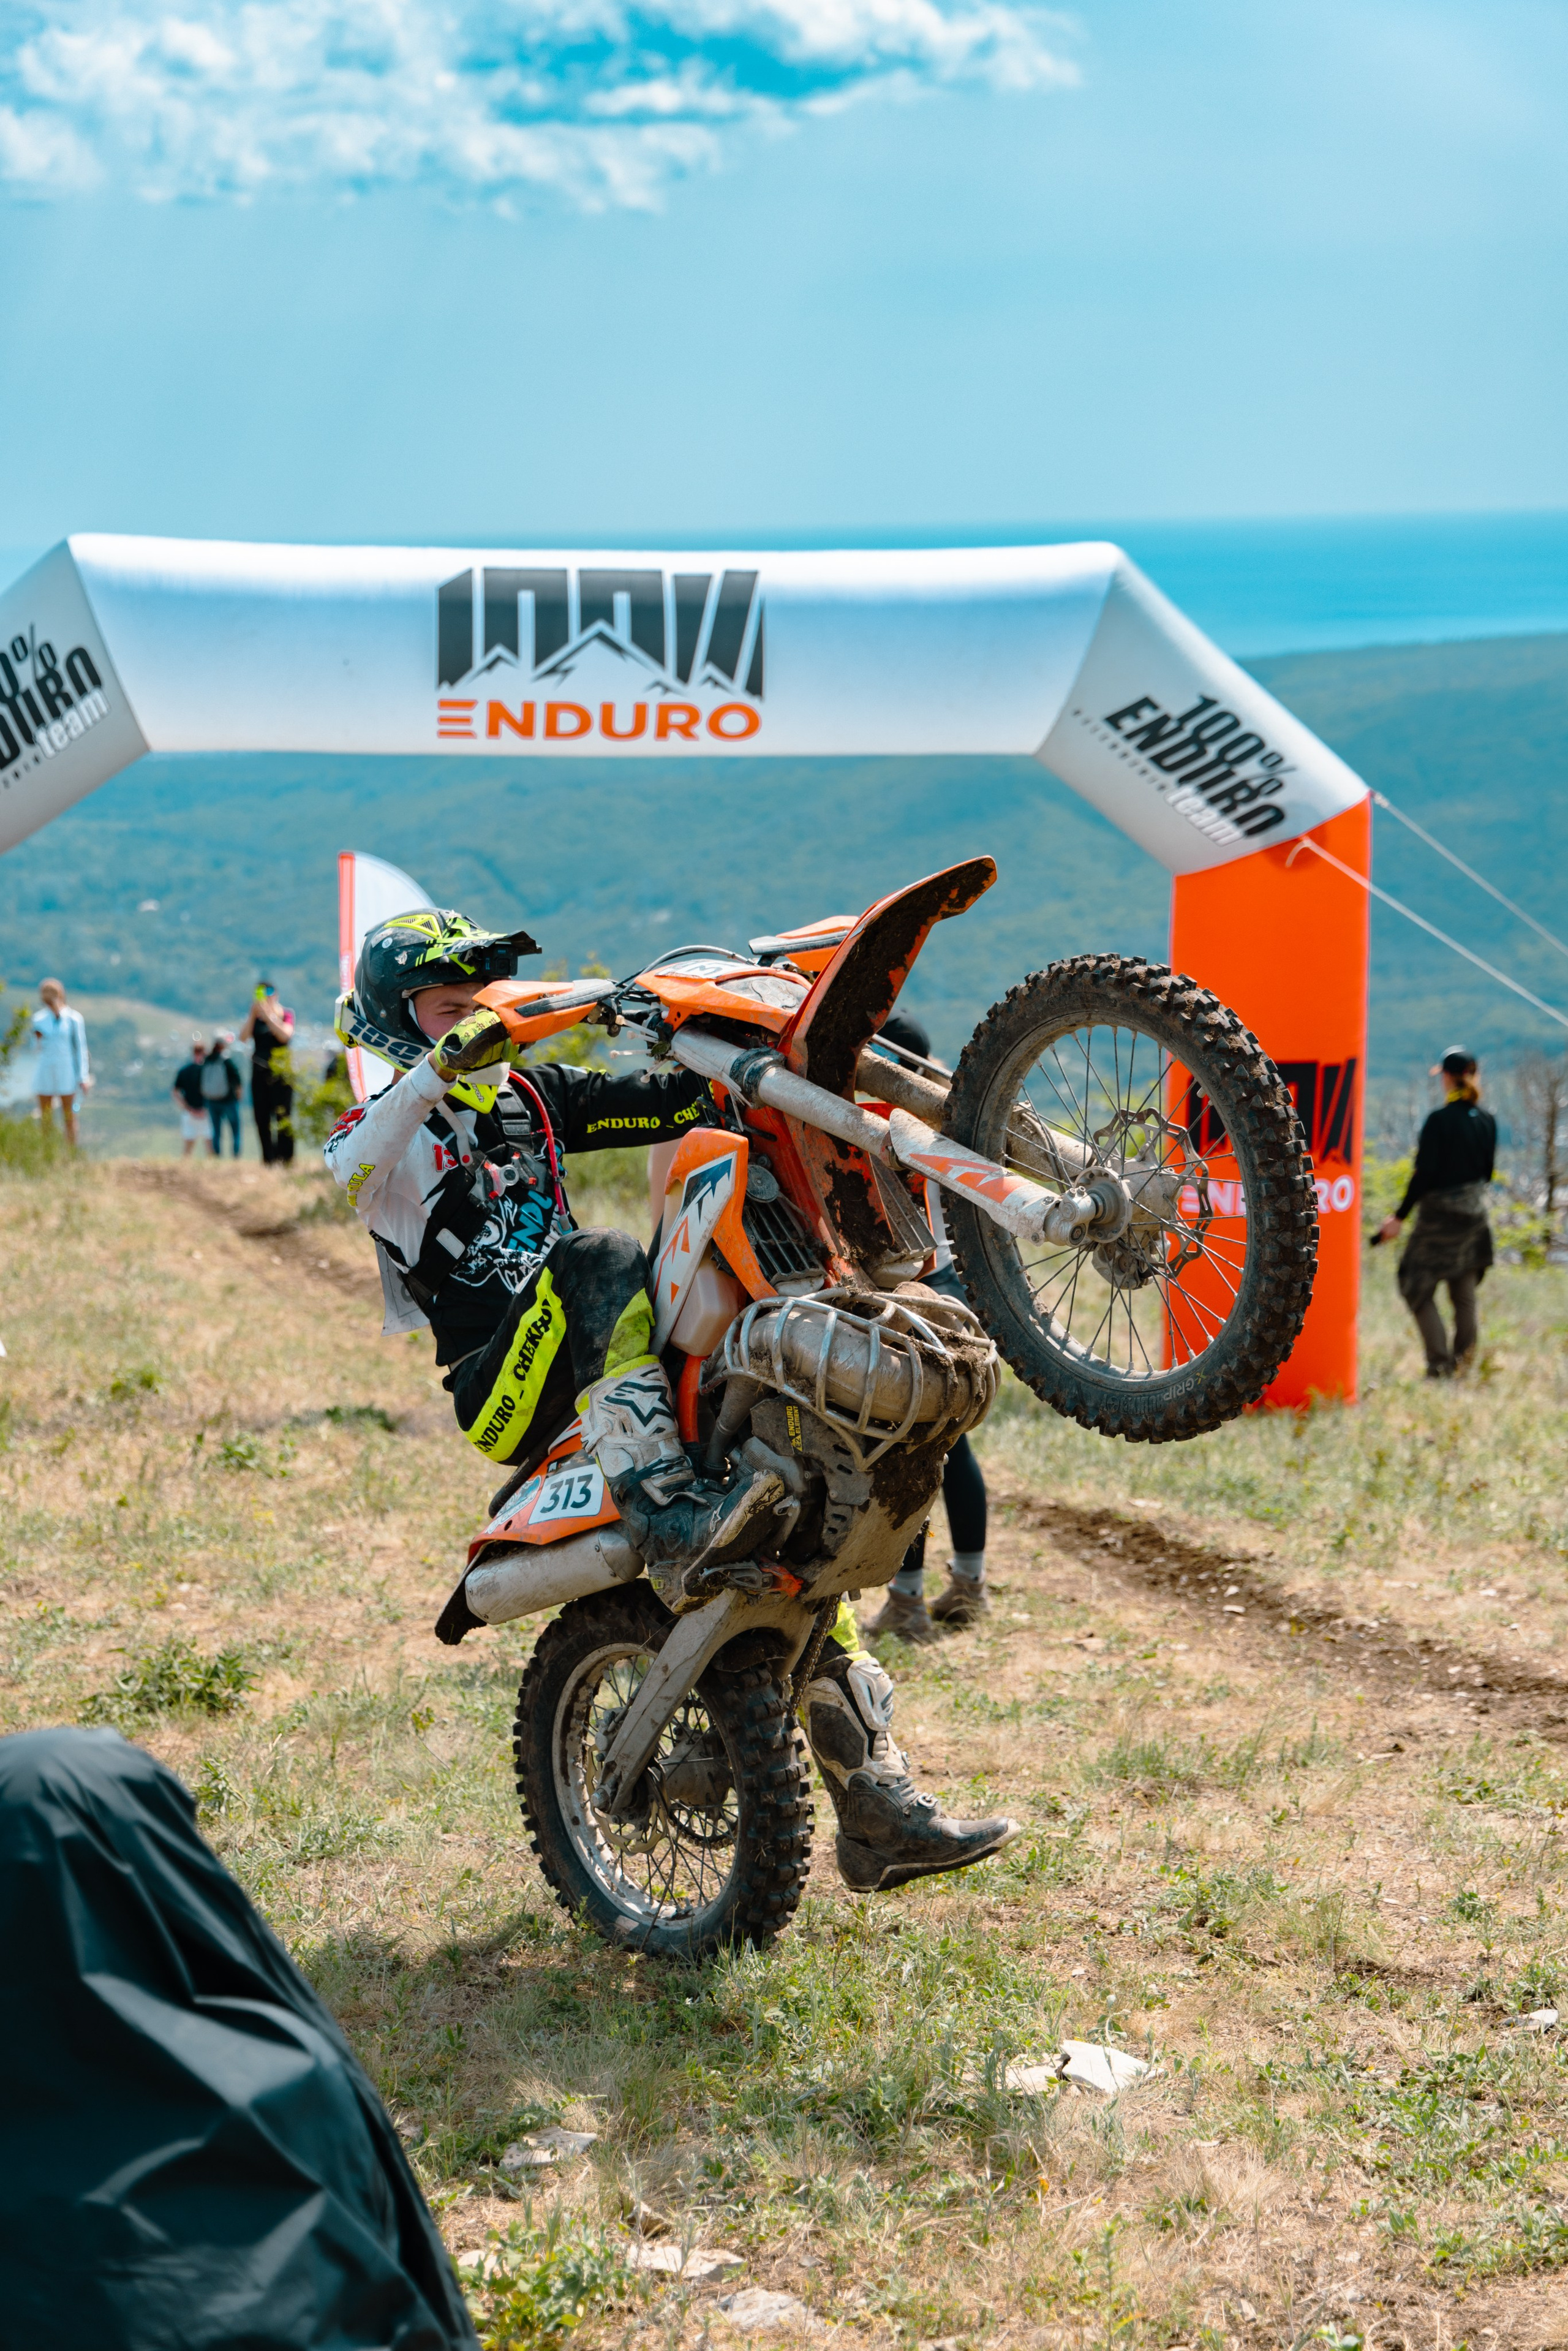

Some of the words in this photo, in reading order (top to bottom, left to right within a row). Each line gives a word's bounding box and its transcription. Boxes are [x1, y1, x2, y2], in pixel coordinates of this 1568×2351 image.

[34, 686, 111, 760] team
[437, 699, 762, 742] ENDURO
[1104, 696, 1285, 837] ENDURO
[1177, 694, 1297, 796] 100%
[1166, 785, 1245, 847] team
[349, 1015, 431, 1061] 100
[586, 1116, 661, 1133] ENDURO
[347, 1163, 376, 1192] ULA
[1181, 1175, 1355, 1215] ENRO
[786, 1405, 796, 1436] ENDURO
[540, 1473, 594, 1514] 313
